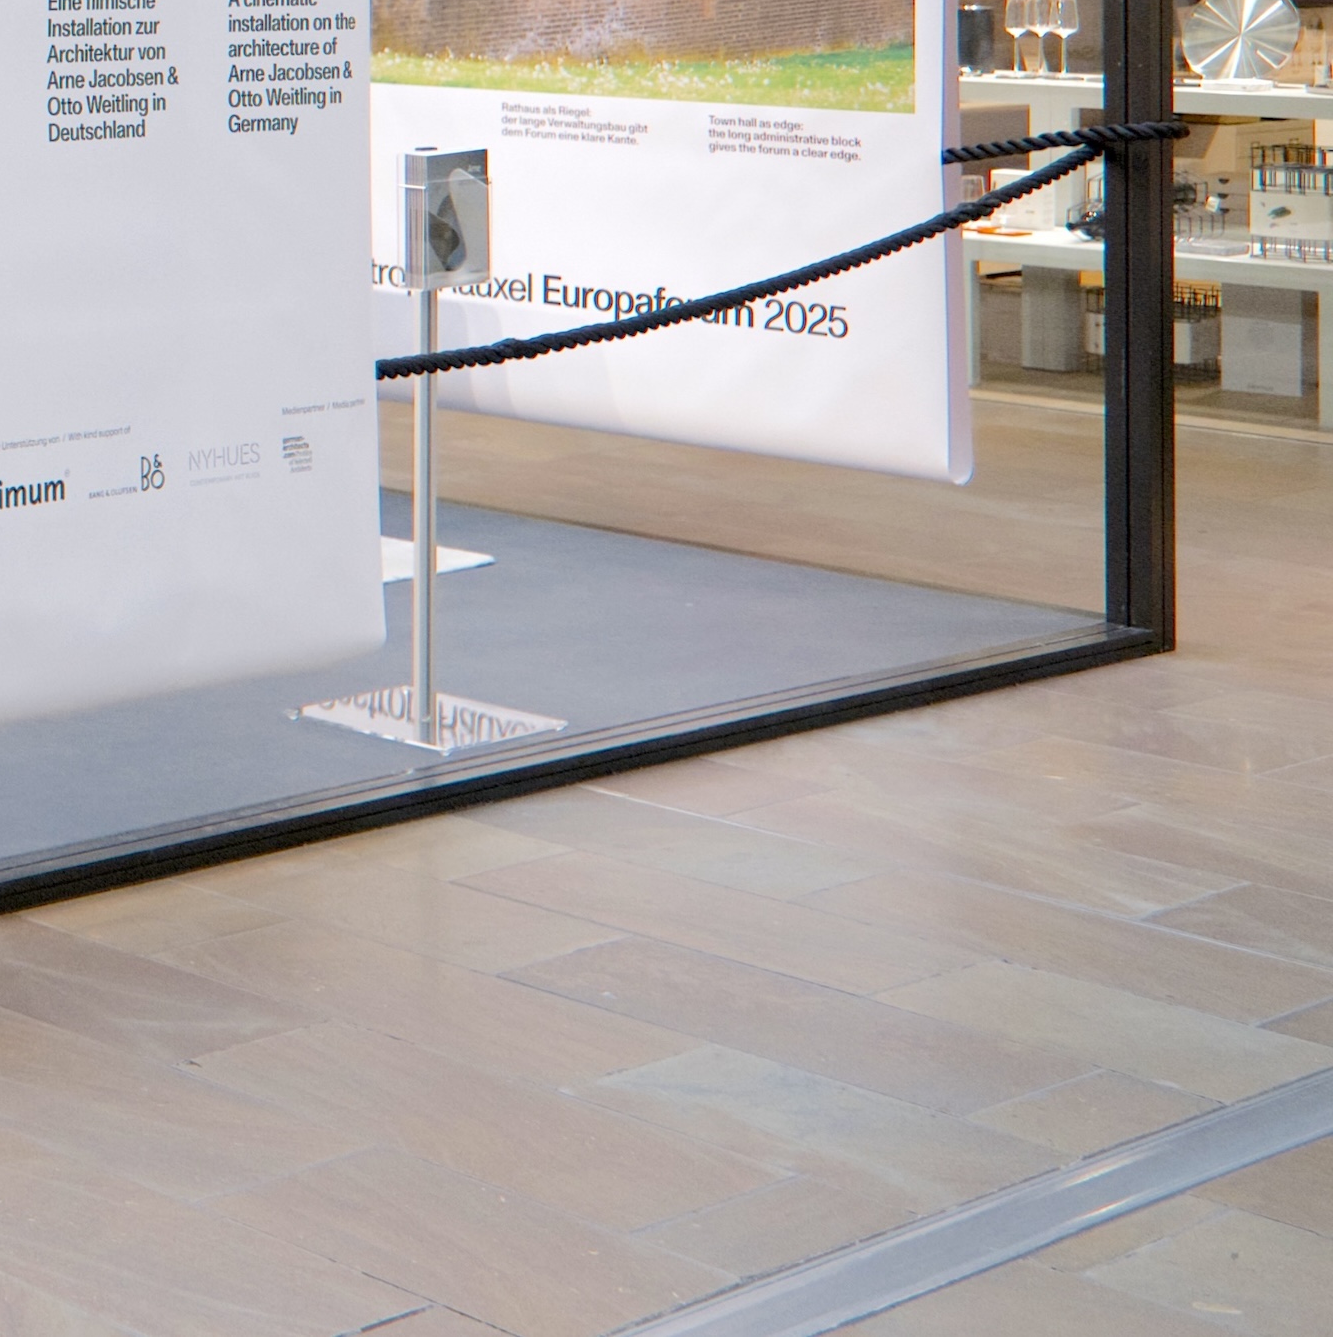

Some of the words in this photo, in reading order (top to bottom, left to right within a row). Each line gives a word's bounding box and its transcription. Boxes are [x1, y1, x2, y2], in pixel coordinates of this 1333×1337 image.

[48, 19, 131, 37] Installation
[136, 19, 159, 35] zur
[228, 14, 309, 32] installation
[313, 16, 331, 30] on
[335, 13, 355, 30] the
[47, 44, 134, 63] Architektur
[138, 45, 165, 60] von
[228, 38, 319, 57] architecture
[323, 37, 337, 55] of
[47, 71, 84, 89] Arne
[89, 67, 164, 89] Jacobsen
[168, 66, 179, 85] &
[228, 64, 264, 82] Arne
[268, 62, 340, 81] Jacobsen
[343, 61, 352, 79] &
[48, 97, 82, 115] Otto
[86, 94, 148, 116] Weitling
[152, 93, 166, 111] in
[228, 89, 262, 108] Otto
[266, 87, 326, 108] Weitling
[329, 87, 342, 104] in
[502, 102, 540, 115] Rathaus
[542, 105, 556, 115] als
[48, 120, 146, 142] Deutschland
[228, 114, 298, 134] Germany
[502, 114, 517, 125] der
[519, 115, 545, 128] lange
[547, 117, 626, 133] Verwaltungsbau
[629, 124, 648, 135] gibt
[709, 115, 735, 127] Town
[738, 116, 756, 128] hall
[759, 121, 771, 129] as
[773, 120, 804, 132] edge:
[502, 127, 522, 138] dem
[525, 128, 556, 140] Forum
[559, 131, 579, 141] eine
[581, 132, 605, 143] klare
[607, 134, 638, 145] Kante.
[709, 128, 724, 139] the
[727, 129, 751, 142] long
[753, 131, 829, 146] administrative
[831, 135, 861, 148] block
[709, 141, 736, 153] gives
[739, 142, 756, 153] the
[758, 143, 790, 155] forum
[801, 146, 827, 159] clear
[830, 149, 861, 162] edge.
[764, 299, 849, 339] 2025
[189, 442, 261, 471] NYHUES
